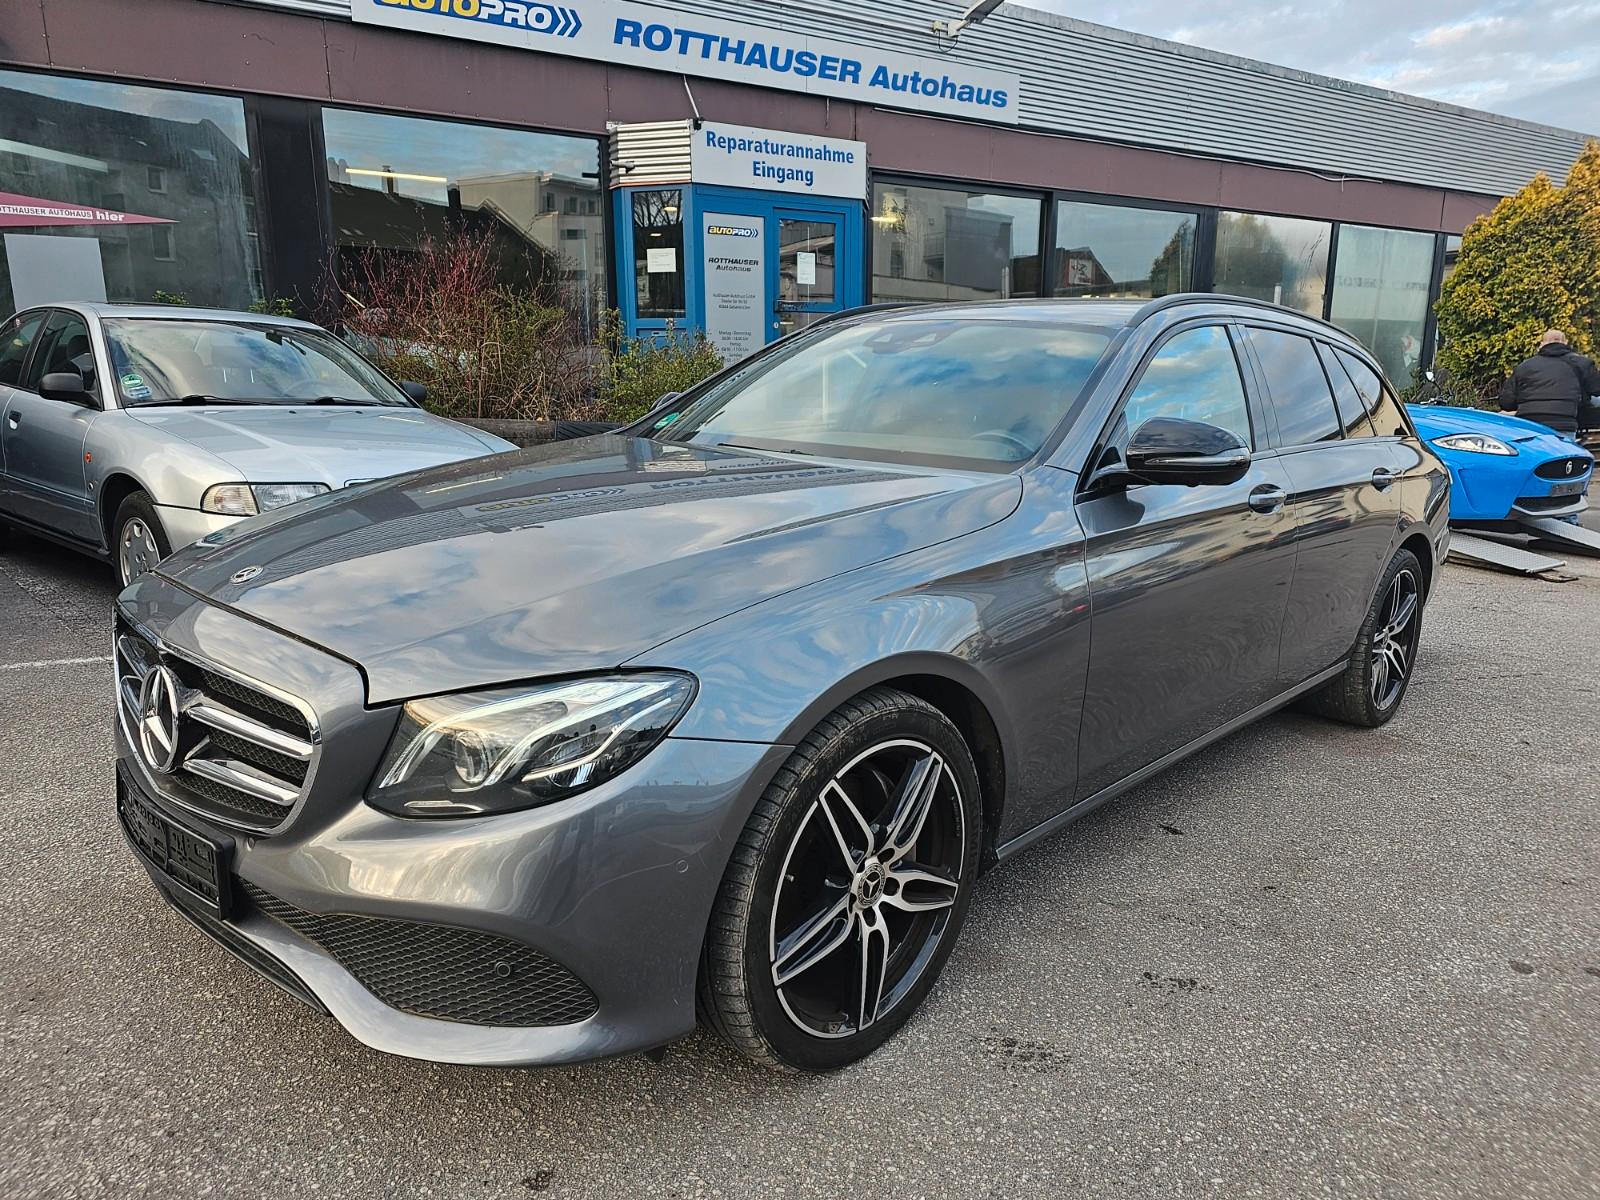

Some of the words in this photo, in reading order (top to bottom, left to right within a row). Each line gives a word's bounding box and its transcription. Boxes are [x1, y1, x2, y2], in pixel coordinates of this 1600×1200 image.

[613, 18, 862, 84] ROTTHAUSER
[868, 65, 1009, 108] Autohaus
[706, 130, 855, 163] Reparaturannahme
[752, 160, 814, 186] Eingang
[0, 206, 46, 215] TTHAUSER
[48, 208, 92, 218] AUTOHAUS
[708, 257, 759, 266] ROTTHAUSER
[716, 264, 752, 273] Autohaus
